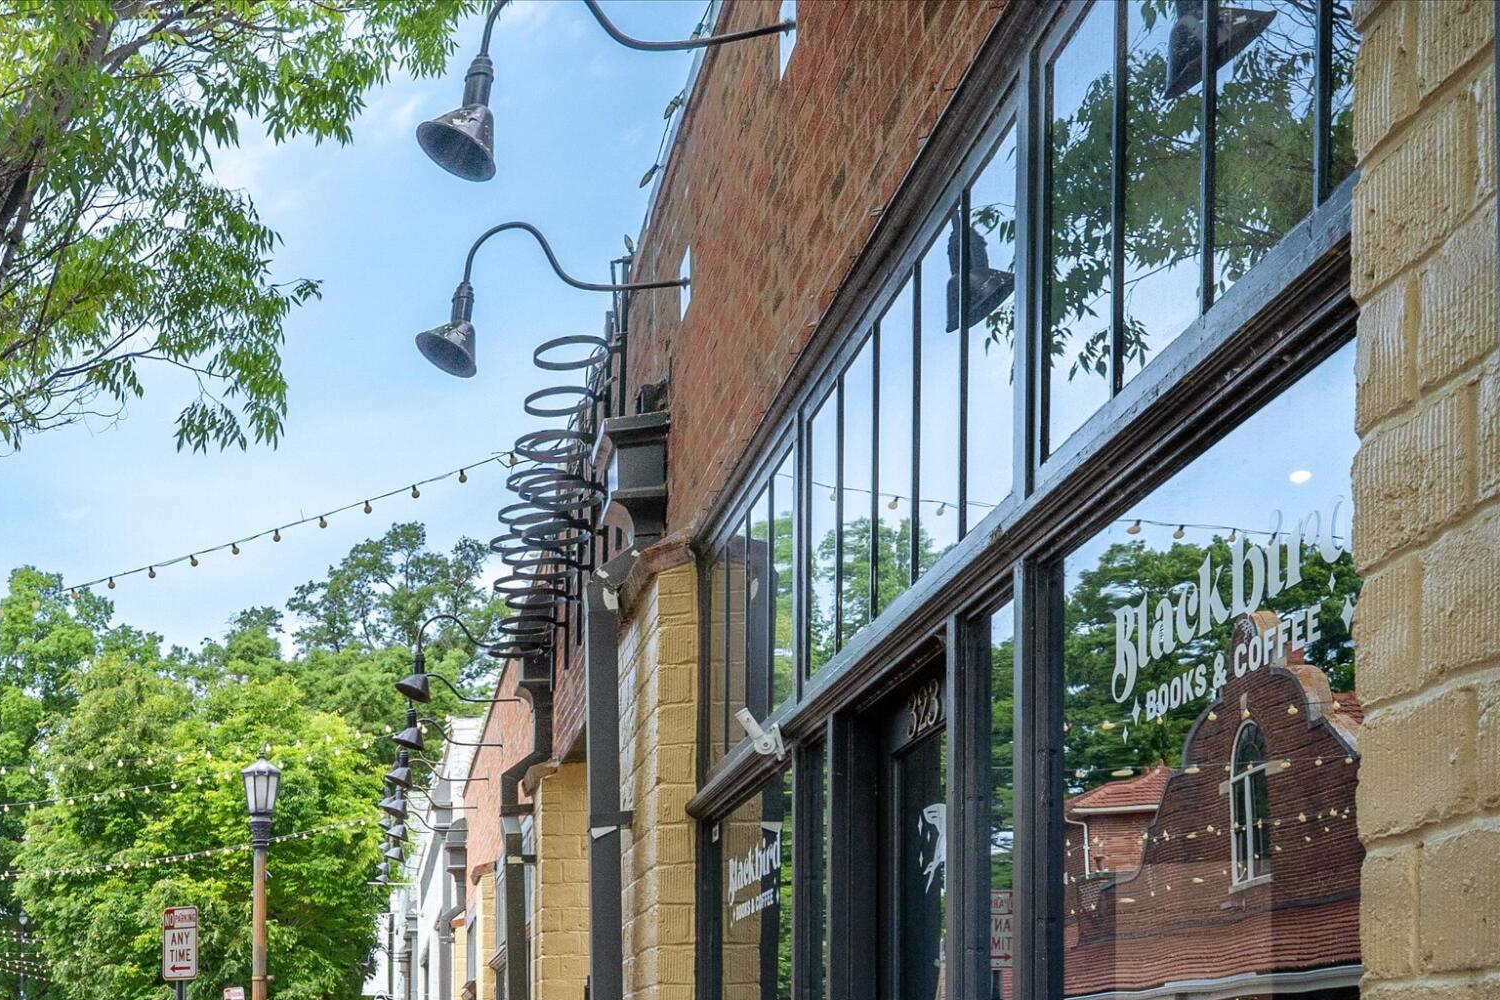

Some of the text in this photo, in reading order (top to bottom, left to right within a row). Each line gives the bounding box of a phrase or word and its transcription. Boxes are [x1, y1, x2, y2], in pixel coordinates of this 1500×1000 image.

[1146, 603, 1322, 721] BOOKS & COFFEE
[907, 679, 939, 738] 323
[728, 829, 781, 906] Blackbird
[165, 913, 196, 927] NO PARKING
[171, 931, 190, 946] ANY
[169, 949, 192, 962] TIME
